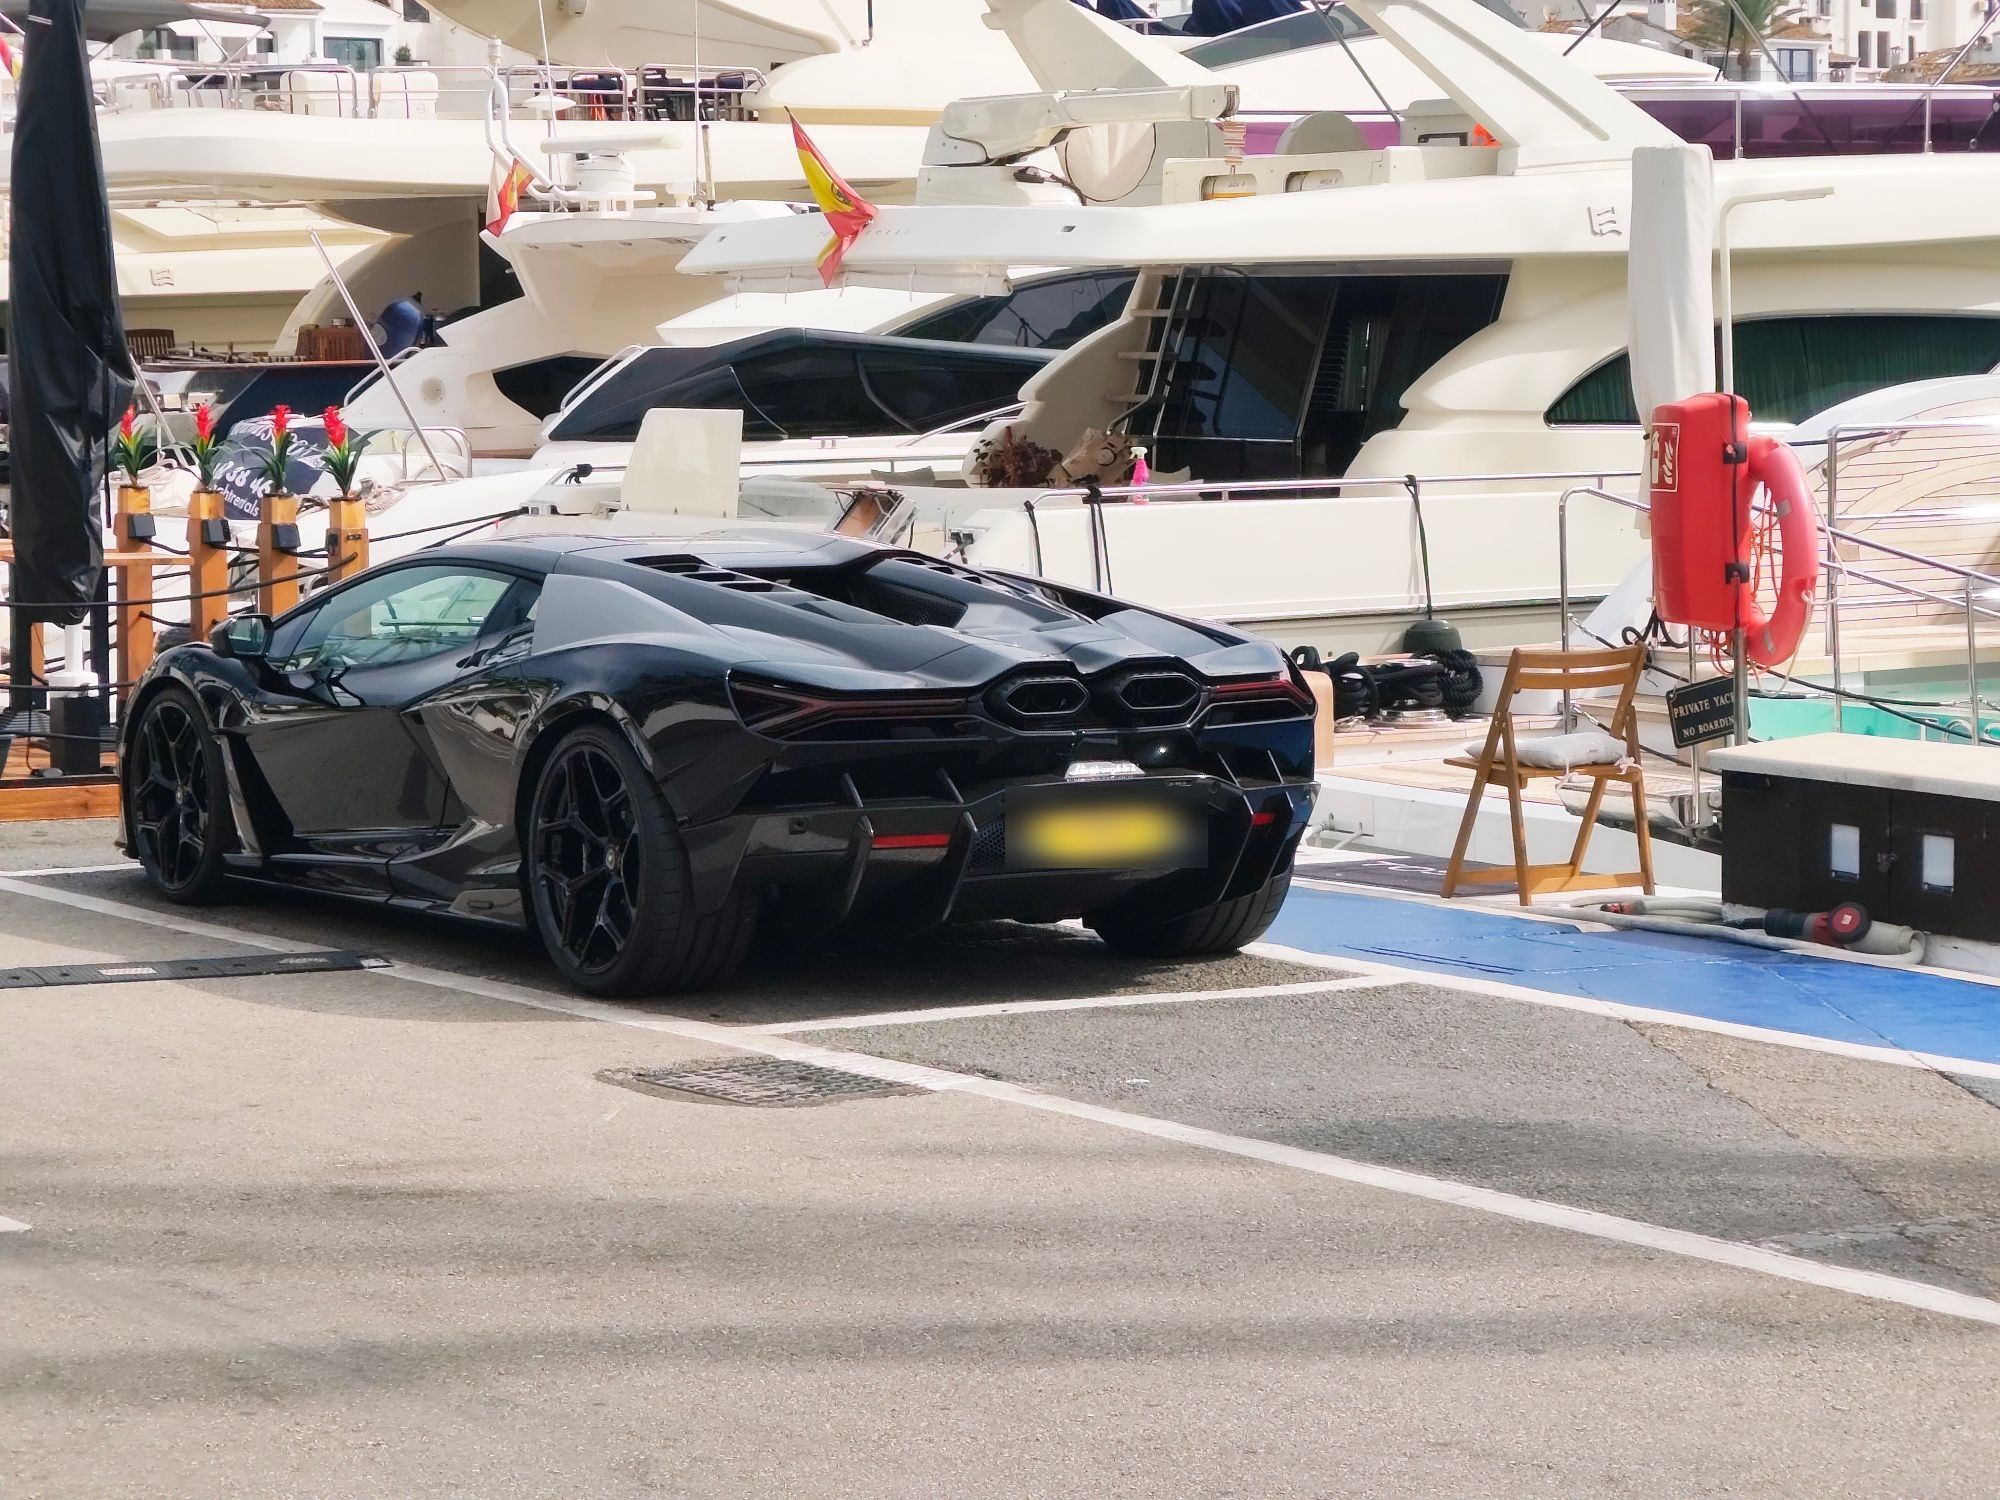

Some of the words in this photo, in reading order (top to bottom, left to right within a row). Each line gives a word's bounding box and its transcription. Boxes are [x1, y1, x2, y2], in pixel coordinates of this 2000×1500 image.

[1673, 699, 1710, 718] PRIVATE
[1682, 726, 1696, 738] NO
[1698, 715, 1735, 734] BOARDIN
